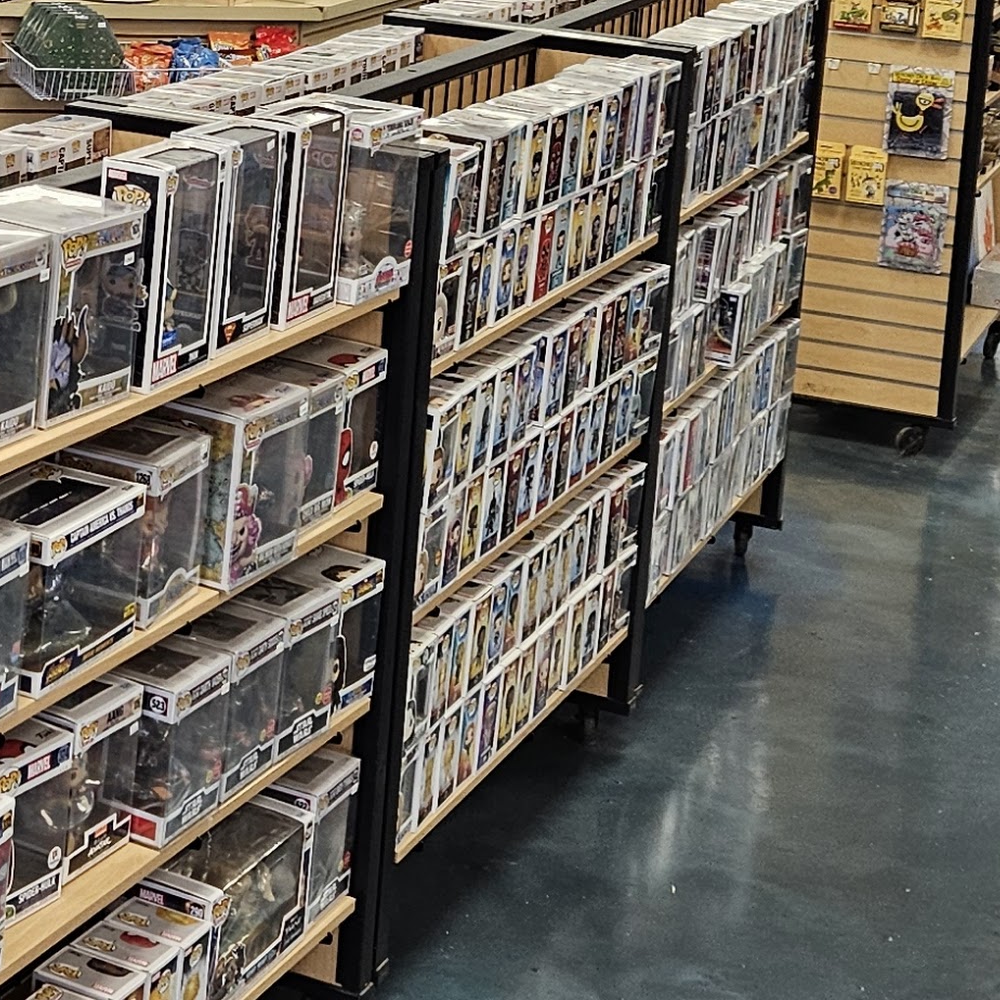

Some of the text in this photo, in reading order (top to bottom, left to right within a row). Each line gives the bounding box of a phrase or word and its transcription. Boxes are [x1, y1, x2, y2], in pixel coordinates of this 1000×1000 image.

[152, 352, 179, 383] MARVEL
[151, 697, 166, 711] 523
[27, 754, 51, 780] MARVEL
[139, 887, 165, 906] MARVEL
